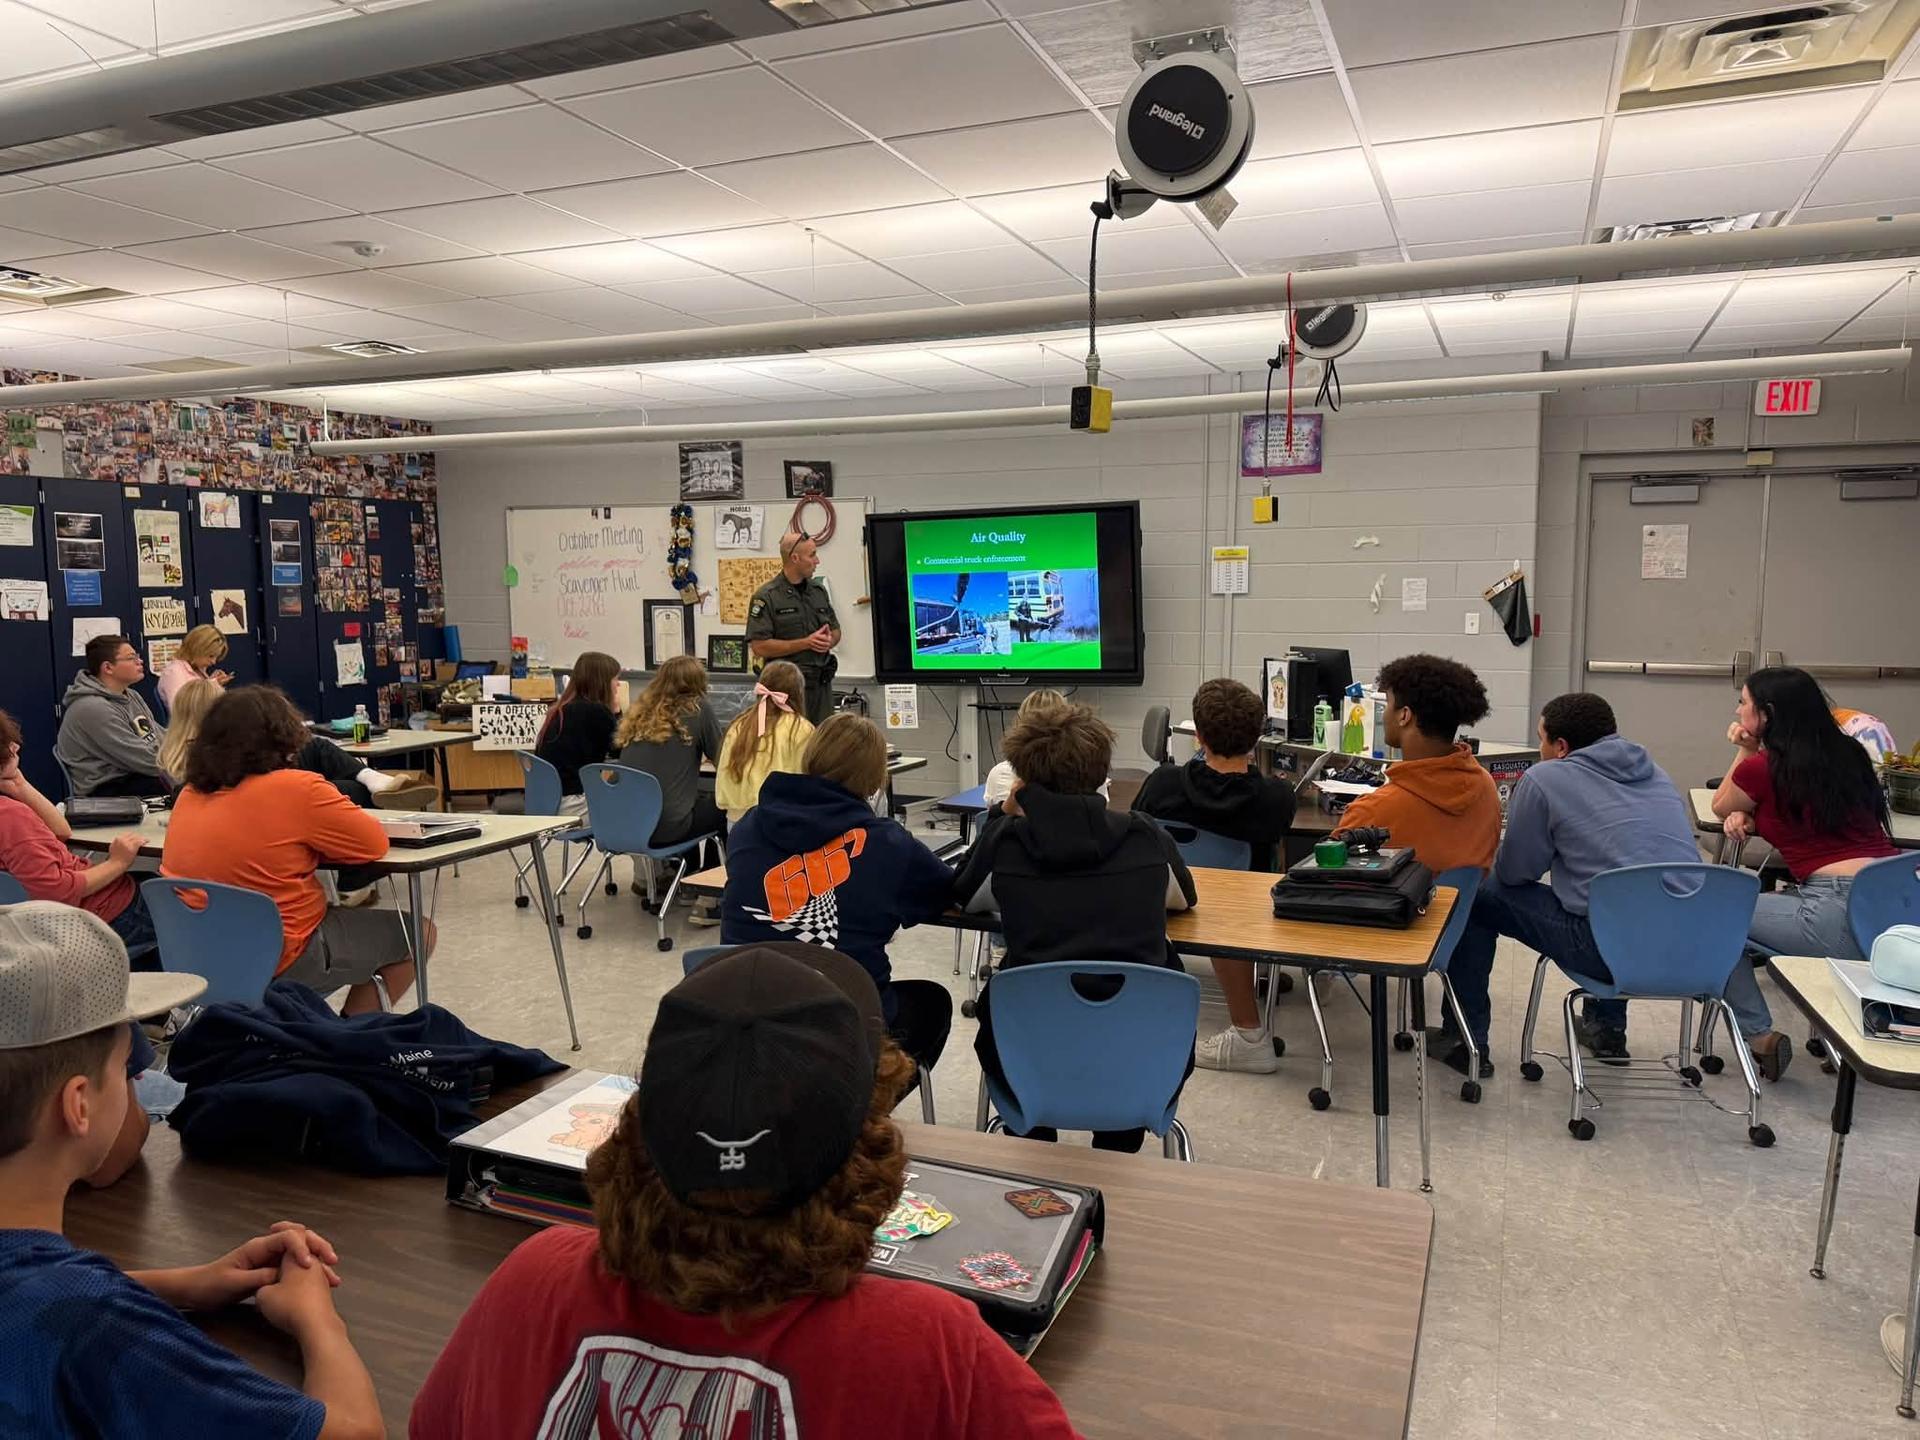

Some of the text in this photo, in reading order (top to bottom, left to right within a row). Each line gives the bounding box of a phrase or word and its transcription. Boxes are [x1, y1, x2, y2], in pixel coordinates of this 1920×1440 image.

[1148, 103, 1195, 135] legrand
[1311, 304, 1336, 326] legran
[1766, 380, 1813, 412] EXIT
[559, 525, 644, 554] October Meeting
[970, 531, 1026, 544] Air Quality
[923, 555, 1026, 565] Commercial truck enforcement
[560, 569, 640, 596] Scavenger Hunt
[480, 705, 501, 715] FFA
[1492, 762, 1529, 771] SASQUATCH
[389, 1049, 433, 1065] Maine
